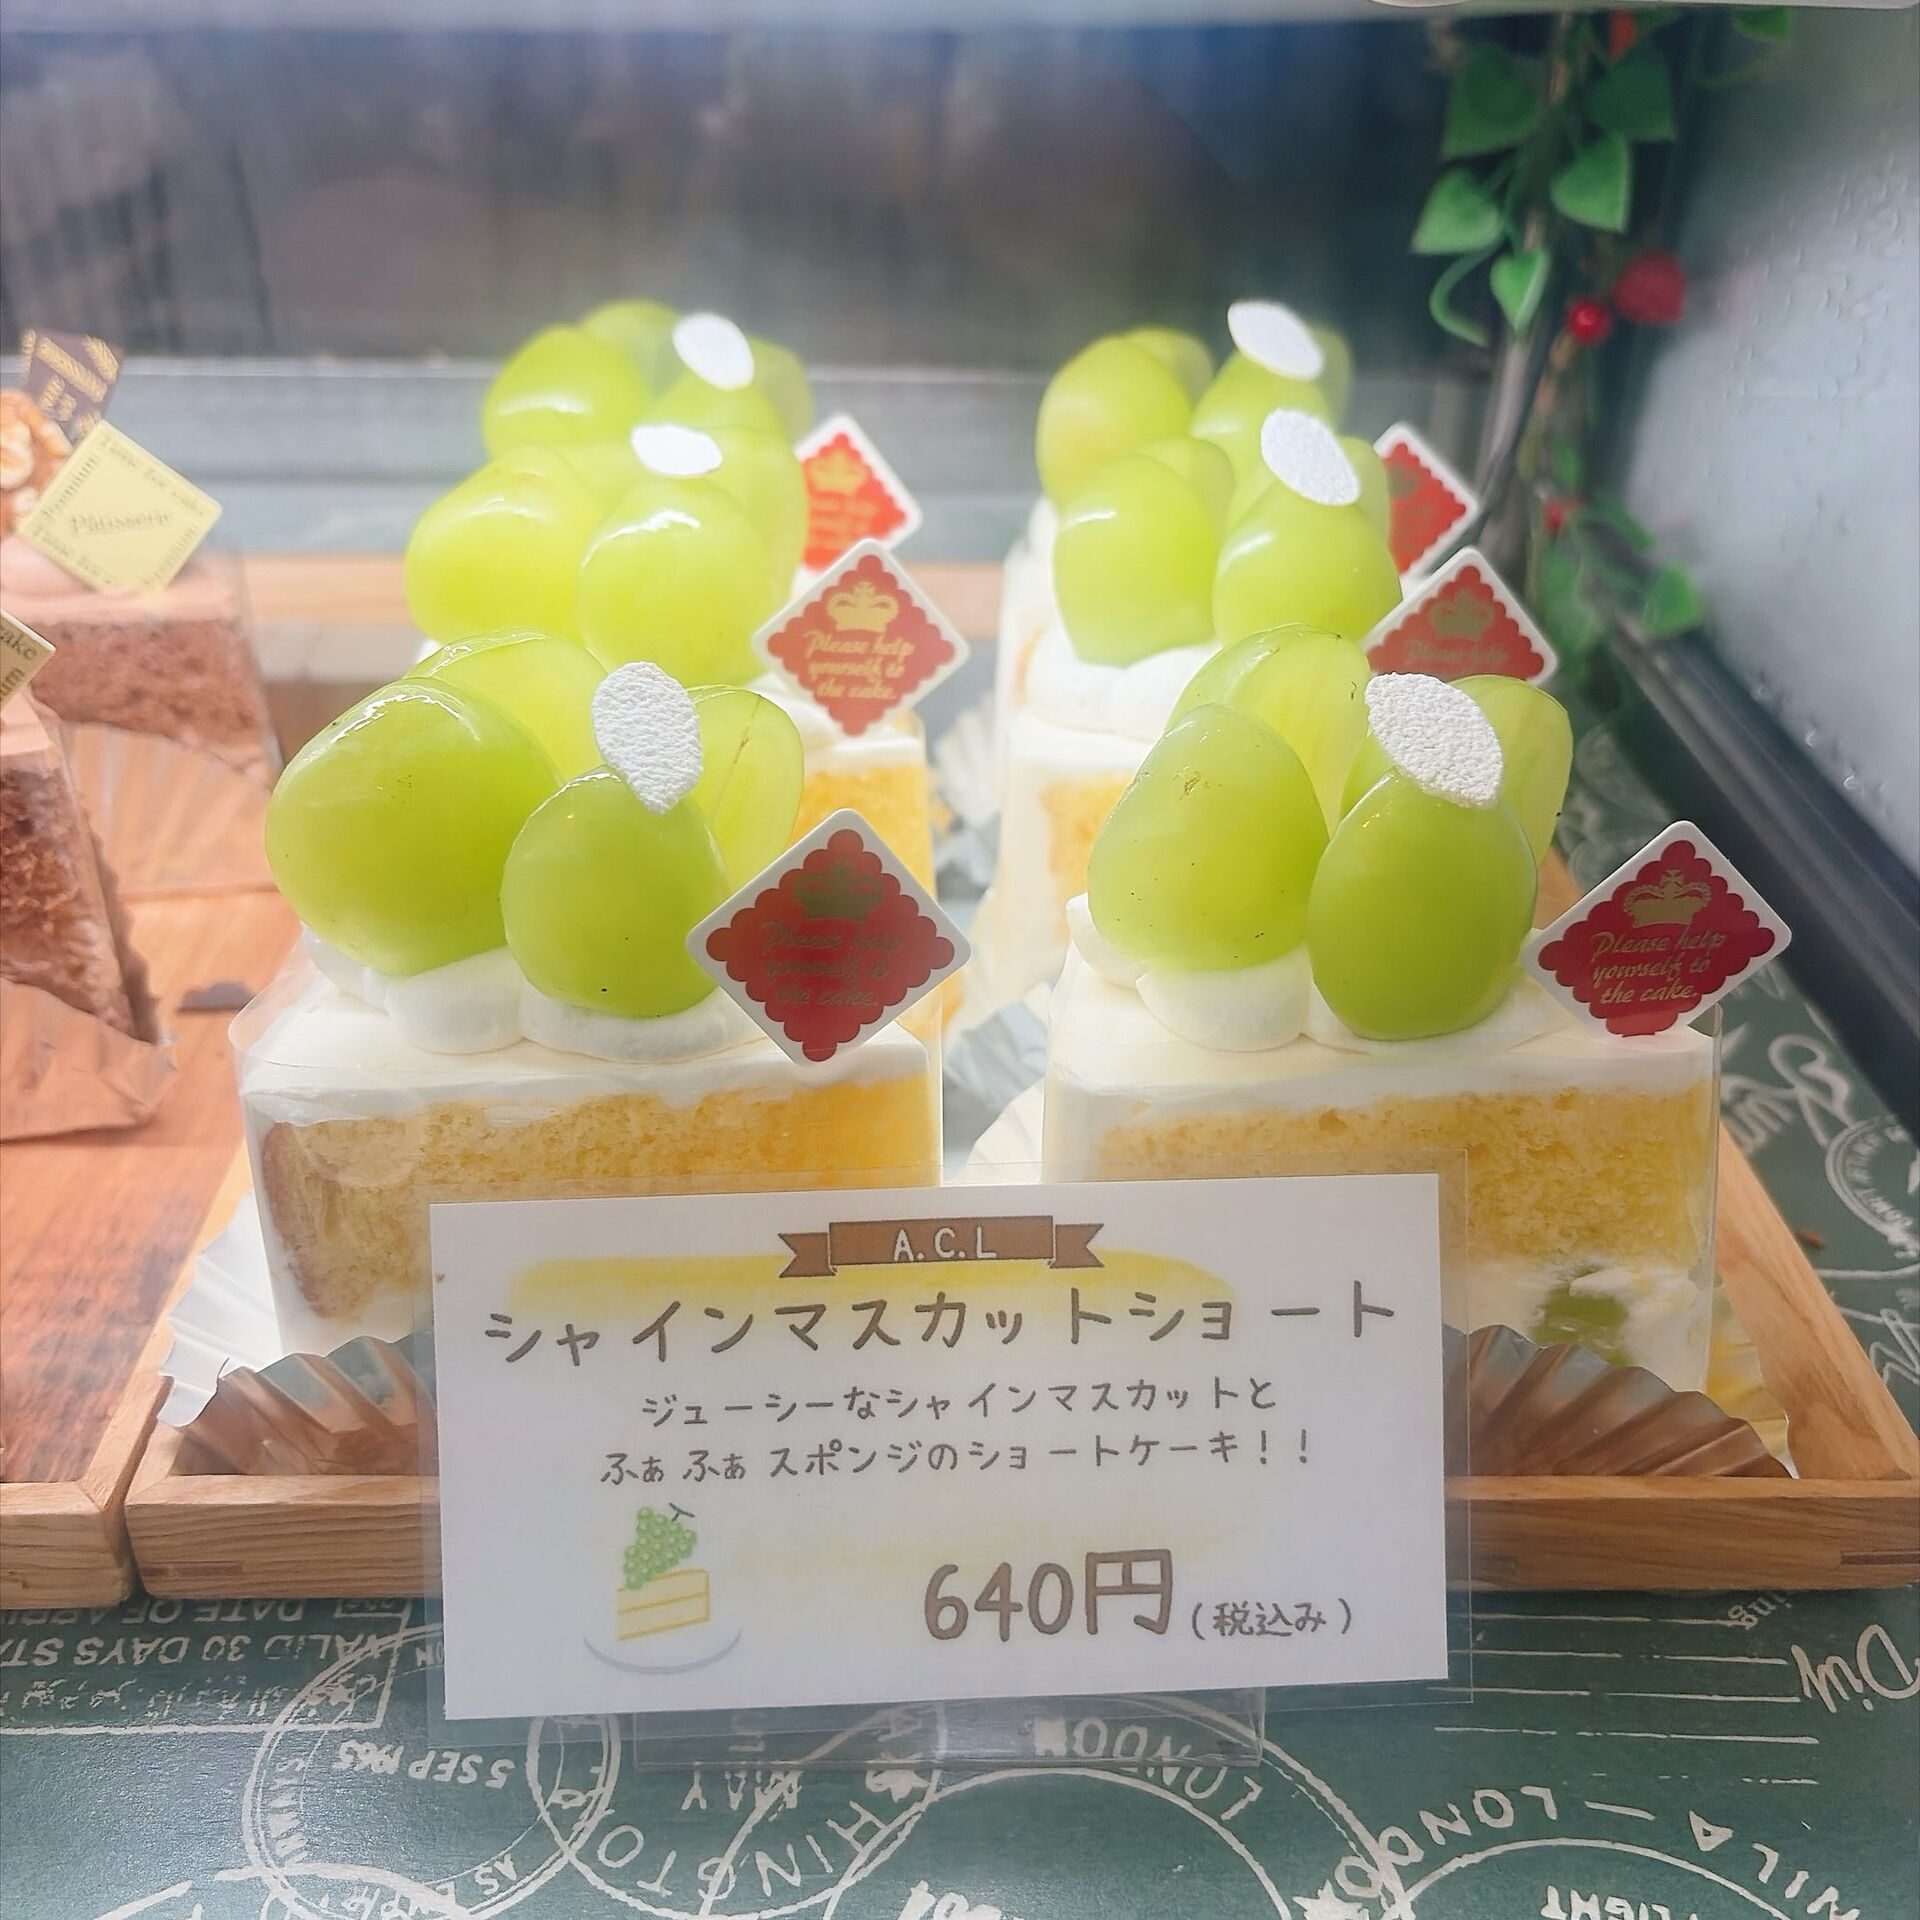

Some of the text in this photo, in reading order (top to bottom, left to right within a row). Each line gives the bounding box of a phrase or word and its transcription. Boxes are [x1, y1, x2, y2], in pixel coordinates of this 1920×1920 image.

[1591, 931, 1670, 963] Please
[1593, 950, 1685, 989] yourself
[1599, 981, 1635, 1004] the
[893, 1225, 998, 1262] A.C.L
[484, 1279, 1396, 1367] シャインマスカットショート
[641, 1376, 1278, 1428] ジューシーなシャインマスカットと
[923, 1547, 1353, 1643] 640円 (税込み)
[73, 1636, 191, 1666] DAYS
